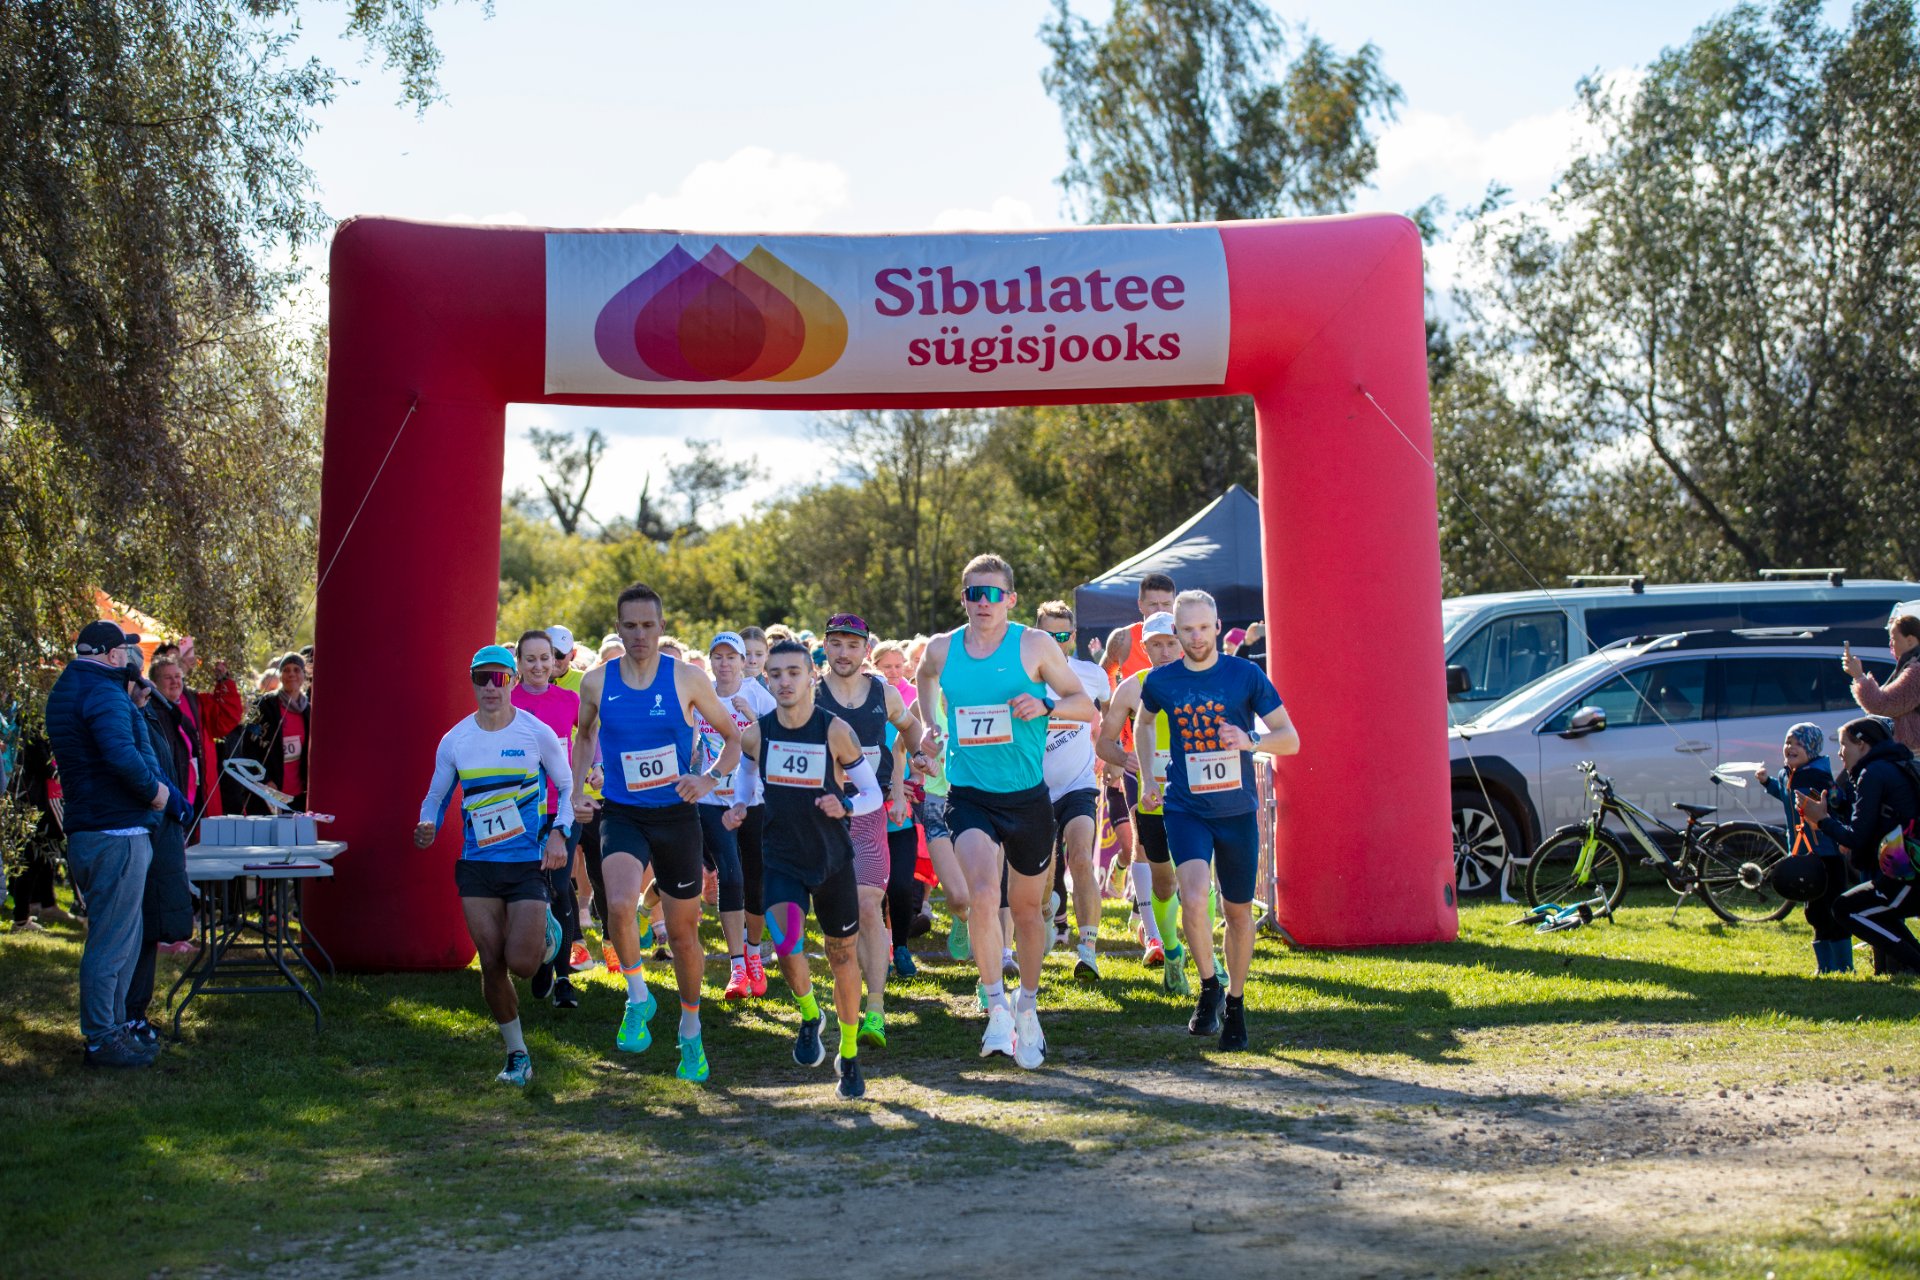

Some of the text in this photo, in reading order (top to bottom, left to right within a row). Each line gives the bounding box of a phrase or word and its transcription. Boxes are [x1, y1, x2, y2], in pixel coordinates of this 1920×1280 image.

[875, 266, 1185, 316] Sibulatee
[908, 322, 1181, 373] sügisjooks
[971, 718, 994, 736] 77
[501, 749, 526, 757] HOKA
[639, 760, 664, 778] 60
[782, 755, 808, 774] 49
[1202, 763, 1226, 780] 10
[482, 815, 506, 835] 71
